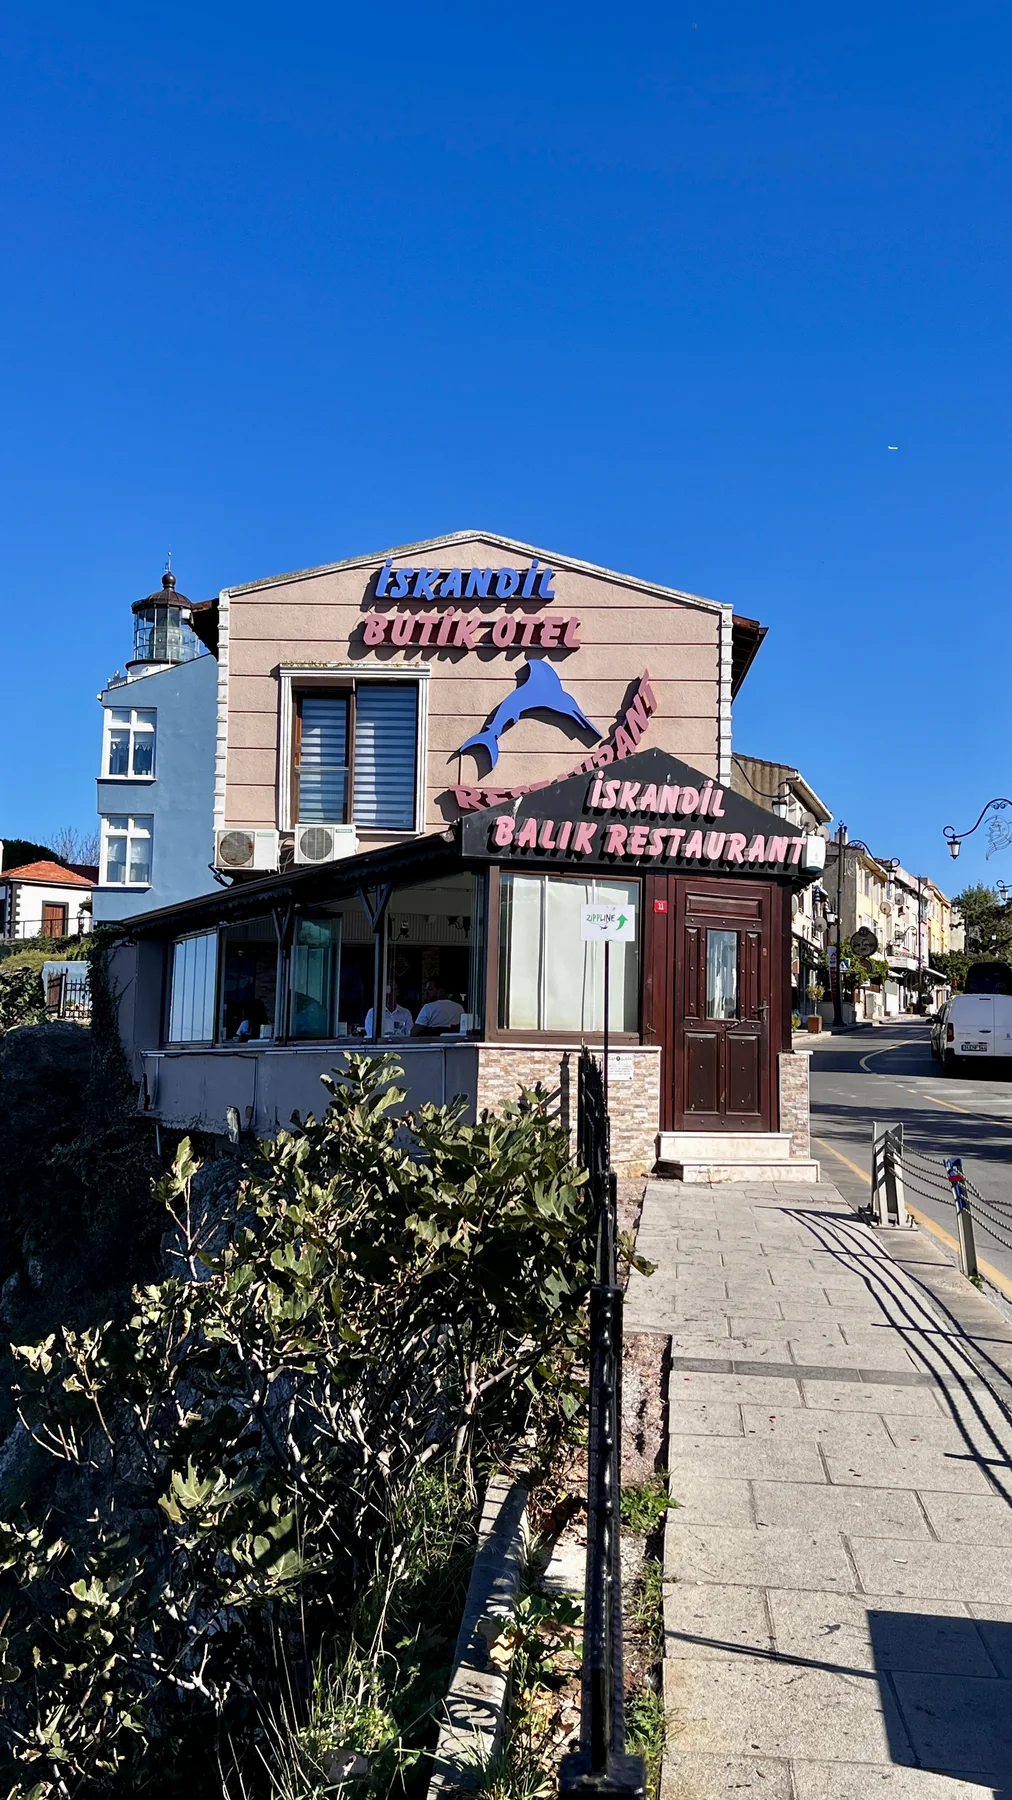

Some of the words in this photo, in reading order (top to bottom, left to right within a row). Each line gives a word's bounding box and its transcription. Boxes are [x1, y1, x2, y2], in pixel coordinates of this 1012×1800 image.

[375, 557, 556, 601] İSKANDİL
[362, 607, 481, 649] BUTİK
[492, 615, 582, 649] OTEL
[588, 770, 727, 818] İSKANDİL
[492, 815, 598, 855] BALIK
[603, 822, 807, 866] RESTAURANT
